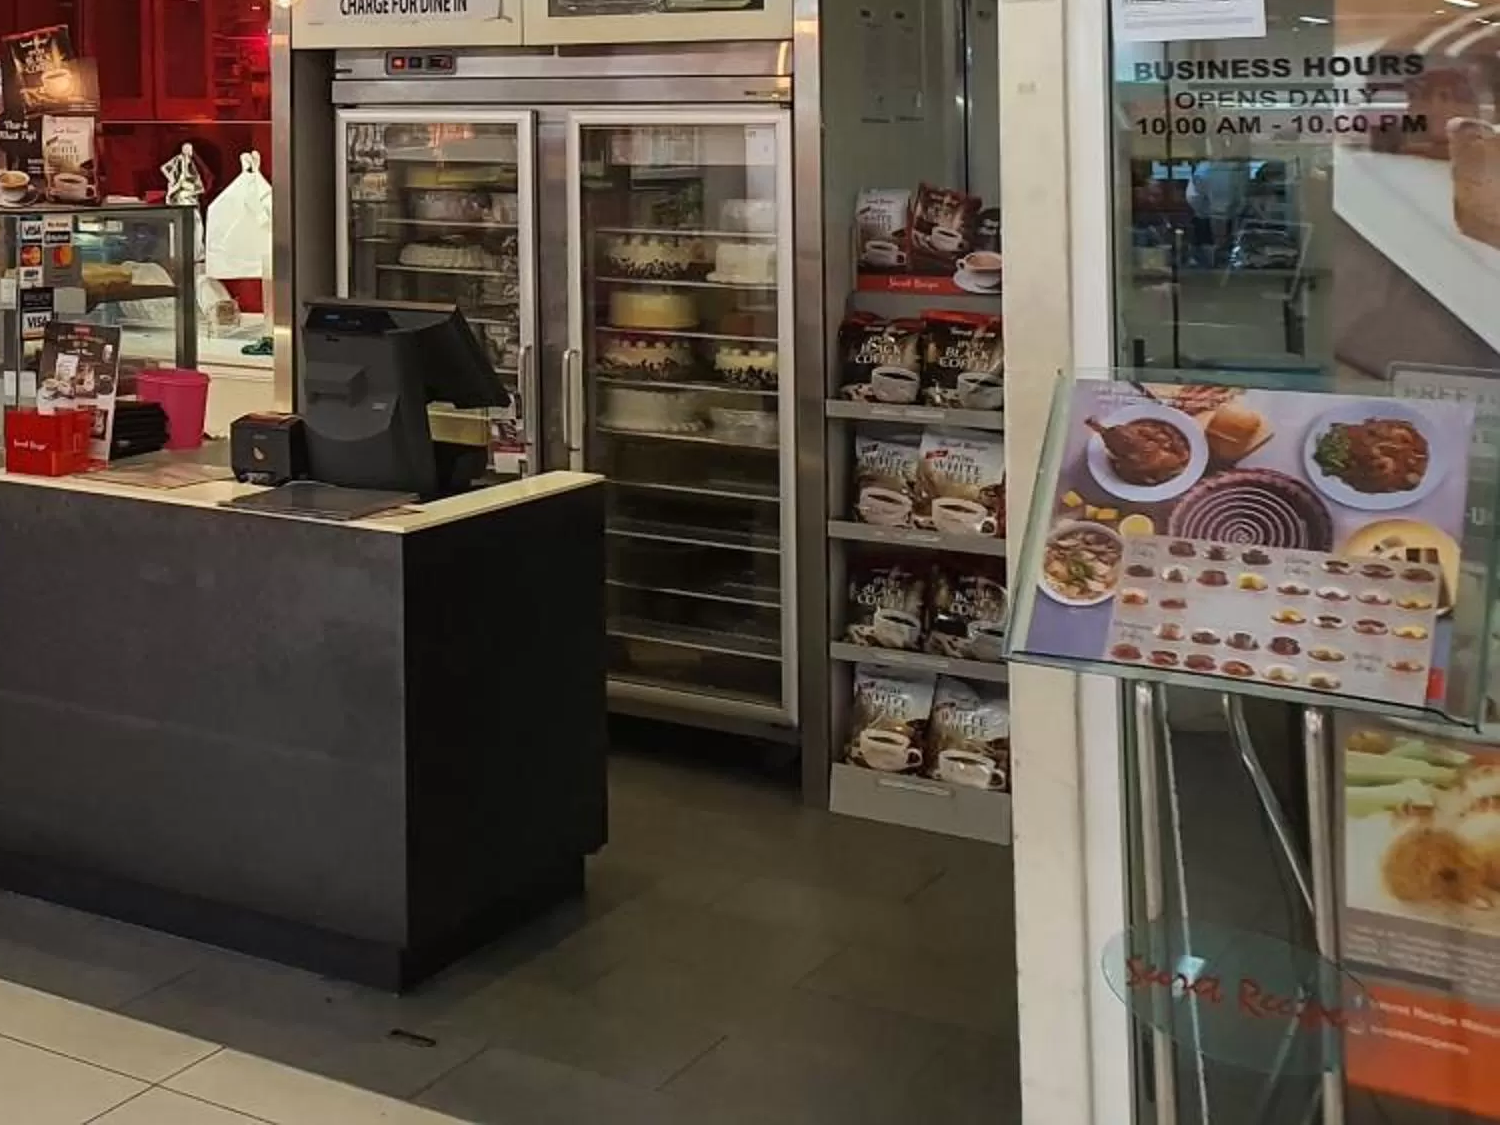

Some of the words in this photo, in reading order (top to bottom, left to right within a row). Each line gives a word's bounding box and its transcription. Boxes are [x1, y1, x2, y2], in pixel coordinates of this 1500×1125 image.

[1134, 56, 1291, 82] BUSINESS
[1303, 53, 1425, 78] HOURS
[1174, 88, 1279, 110] OPENS
[1288, 87, 1379, 108] DAILY
[1216, 115, 1261, 135] AM
[1380, 114, 1428, 133] PM
